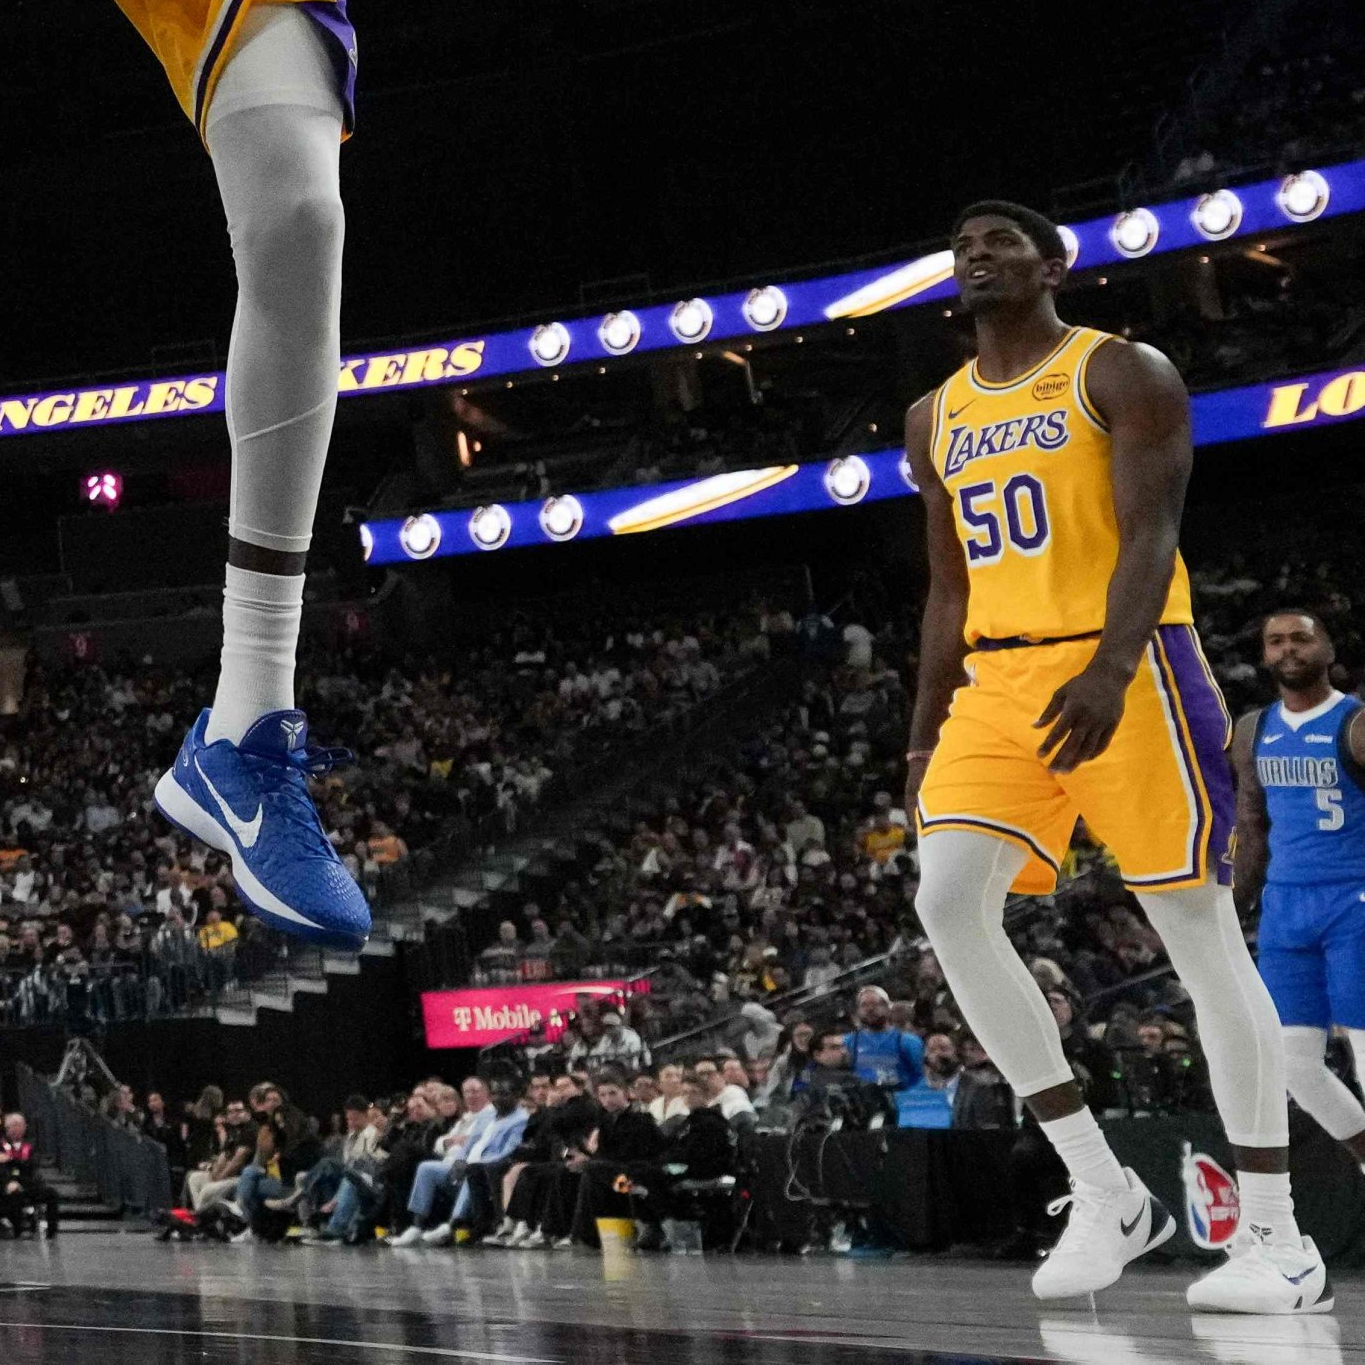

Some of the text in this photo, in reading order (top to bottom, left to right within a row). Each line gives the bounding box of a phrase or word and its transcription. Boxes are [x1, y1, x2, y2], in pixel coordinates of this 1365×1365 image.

[337, 339, 486, 392] KERS
[944, 410, 1069, 480] LAKERS
[958, 473, 1050, 567] 50
[1257, 756, 1338, 787] DALLAS
[1316, 788, 1345, 831] 5
[473, 1003, 542, 1031] Mobile
